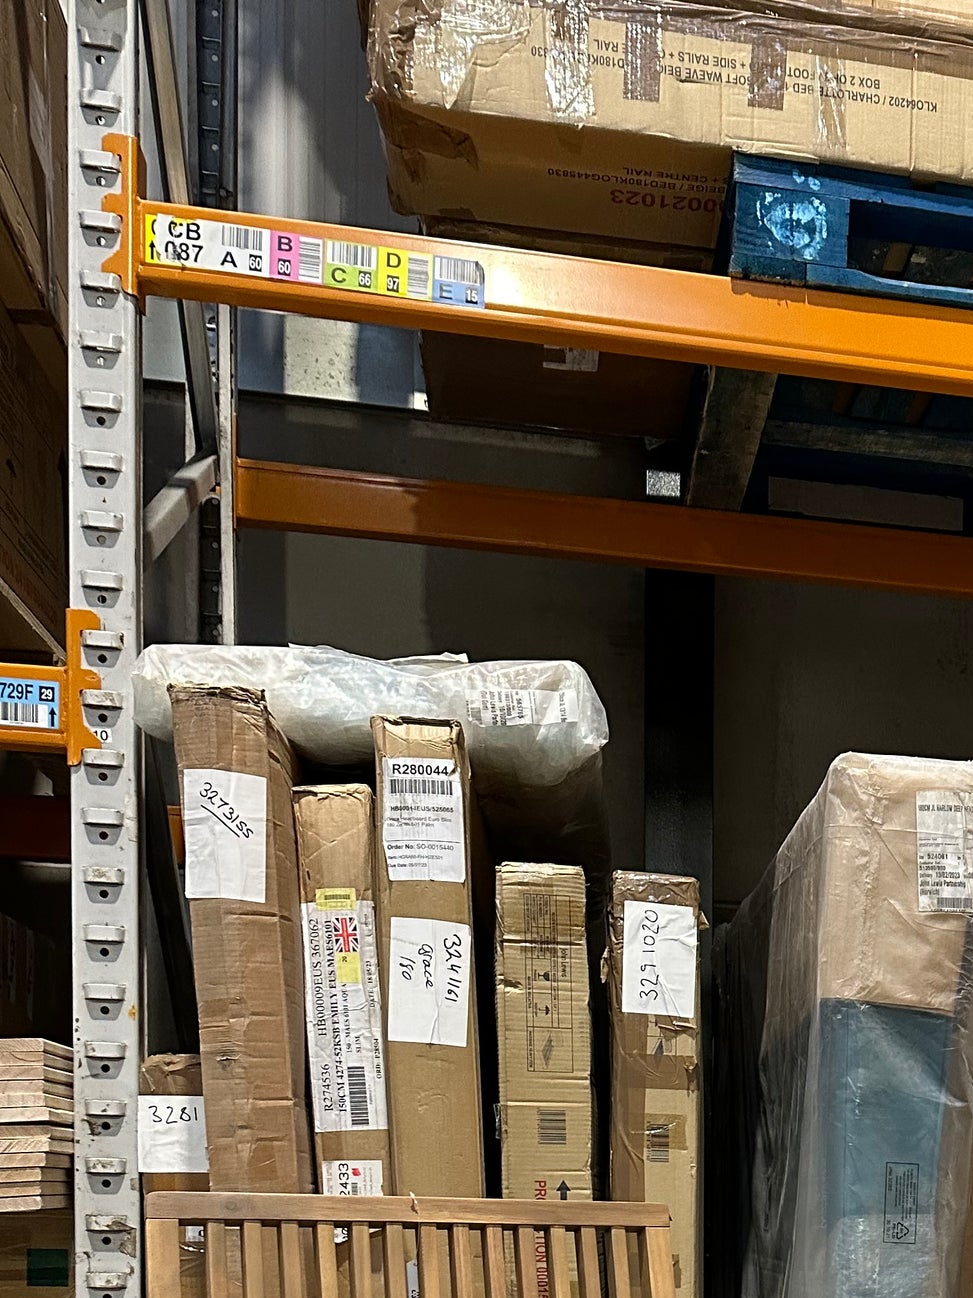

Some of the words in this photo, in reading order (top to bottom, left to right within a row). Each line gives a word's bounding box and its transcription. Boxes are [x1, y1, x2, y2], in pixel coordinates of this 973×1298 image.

[593, 38, 619, 51] RAIL
[678, 51, 710, 65] RAILS
[712, 56, 737, 69] SIDE
[793, 84, 814, 94] BED
[858, 79, 881, 89] BOX
[609, 188, 725, 213] 0021023
[168, 221, 201, 240] CB
[164, 240, 203, 263] 087
[277, 236, 293, 252] B
[221, 251, 238, 268] A
[249, 256, 262, 270] 60
[386, 252, 402, 268] D
[277, 261, 291, 274] 60
[331, 267, 347, 283] C
[358, 272, 371, 287] 66
[387, 277, 400, 291] 97
[439, 283, 453, 300] E
[466, 289, 478, 302] 15
[0, 682, 34, 700] 729F
[41, 688, 53, 700] 29
[93, 730, 108, 741] 10
[391, 763, 449, 776] R280044
[309, 918, 321, 958] 367062
[320, 1063, 334, 1112] R274536
[337, 1082, 347, 1112] 150CM
